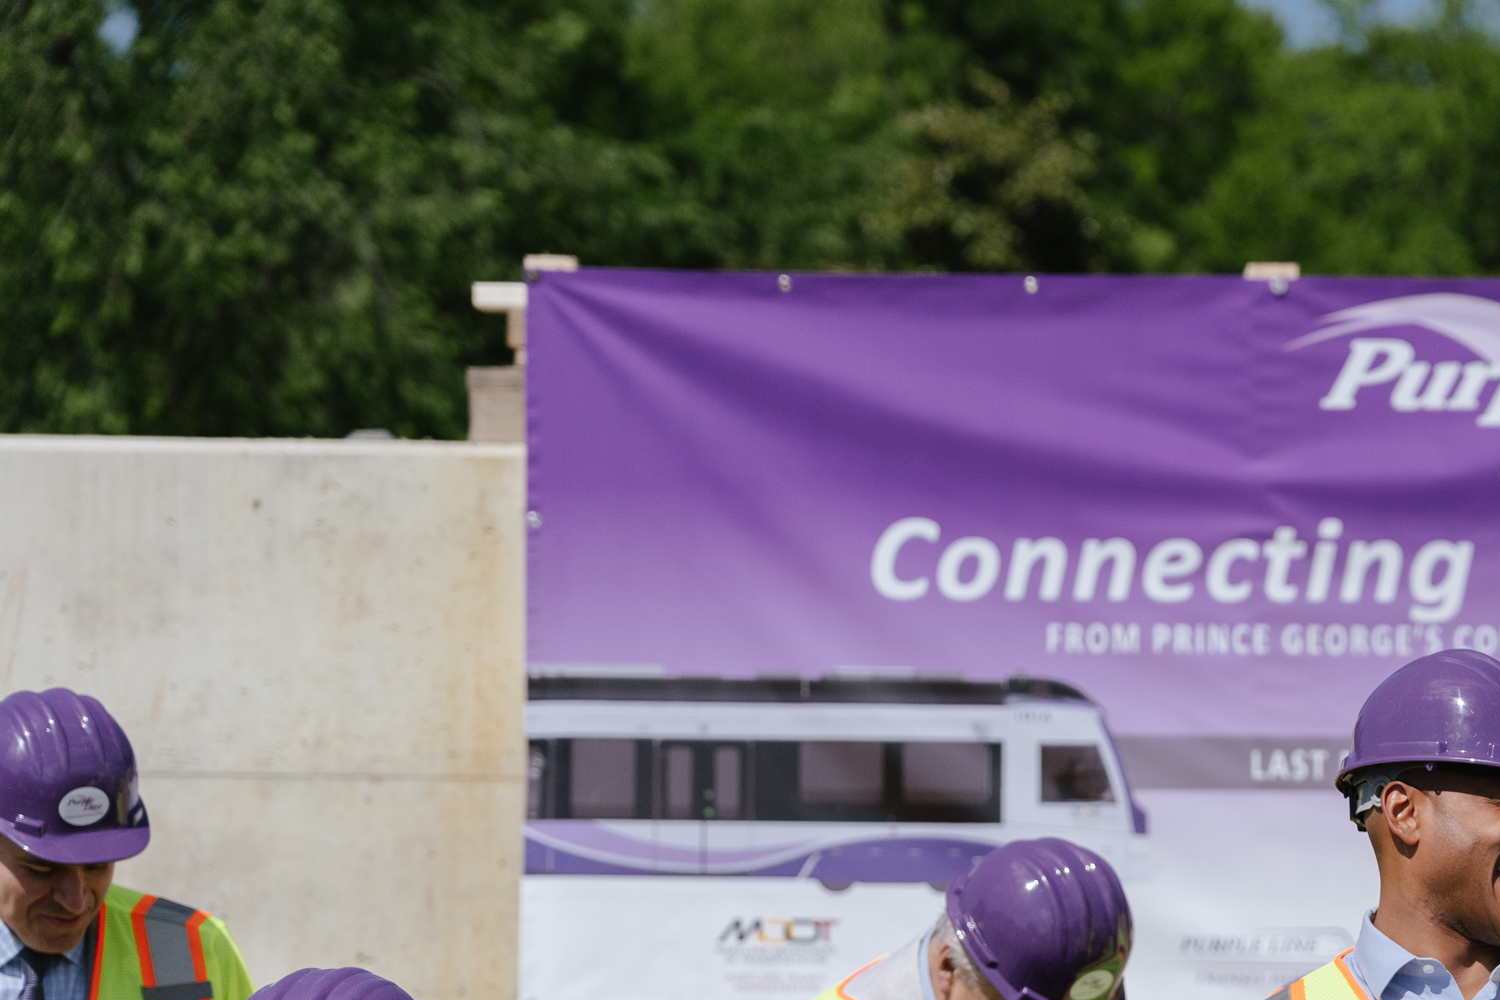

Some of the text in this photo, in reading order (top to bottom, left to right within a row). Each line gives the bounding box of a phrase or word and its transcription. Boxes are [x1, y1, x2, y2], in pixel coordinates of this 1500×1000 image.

[870, 516, 1476, 624] Connecting
[1046, 622, 1142, 656] FROM
[1153, 622, 1271, 656] PRINCE
[1281, 622, 1444, 657] GEORGE'S
[1249, 748, 1330, 782] LAST
